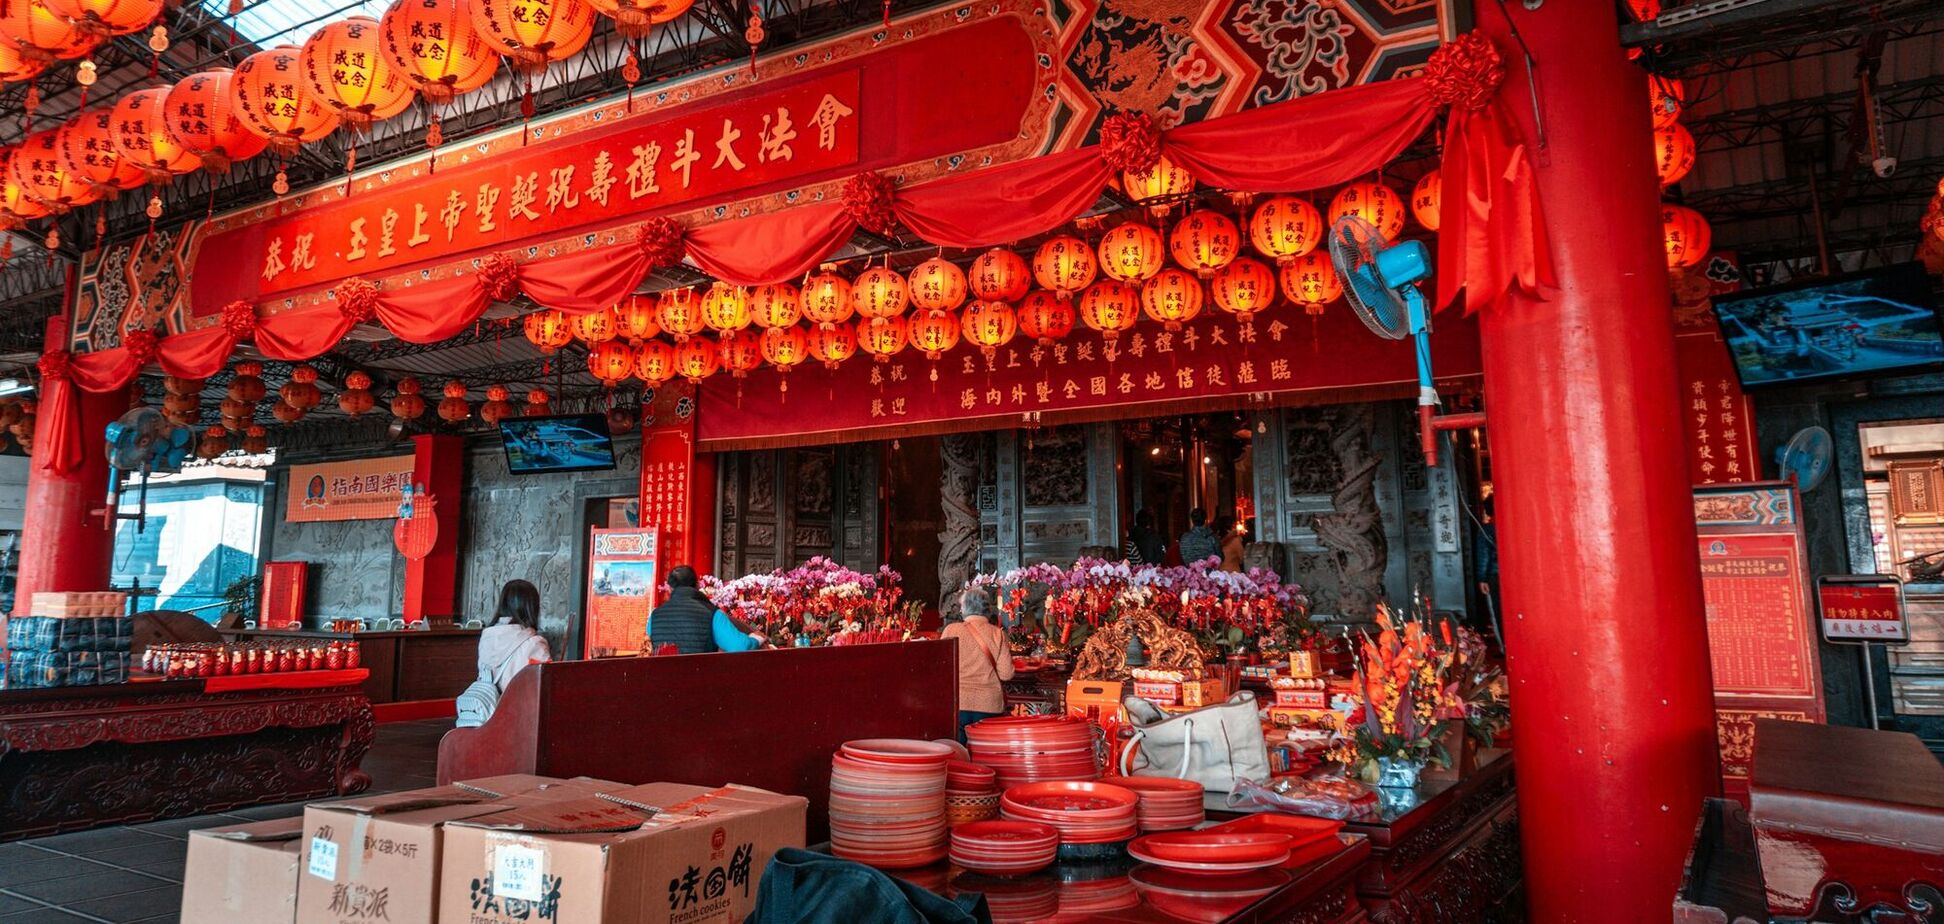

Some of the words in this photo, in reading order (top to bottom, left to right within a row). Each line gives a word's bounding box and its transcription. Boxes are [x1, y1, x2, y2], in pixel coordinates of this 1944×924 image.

[513, 5, 549, 26] 紀念
[347, 24, 368, 39] 宮
[411, 20, 445, 41] 成道
[334, 50, 367, 69] 成道
[411, 42, 446, 62] 紀念
[274, 55, 295, 71] 宮
[333, 69, 368, 88] 紀念
[264, 83, 296, 101] 成道
[179, 103, 207, 118] 成道
[264, 102, 298, 118] 紀念
[121, 120, 146, 135] 成道
[180, 121, 209, 135] 紀念
[261, 232, 317, 282] 恭祝
[346, 93, 853, 262] 玉皇上帝聖誕祝壽禮斗大法會
[1286, 222, 1304, 233] 成道
[1122, 246, 1140, 256] 成道
[1072, 261, 1091, 271] 成道
[923, 282, 940, 291] 成道
[868, 364, 908, 386] 恭祝
[870, 396, 908, 419] 歡迎
